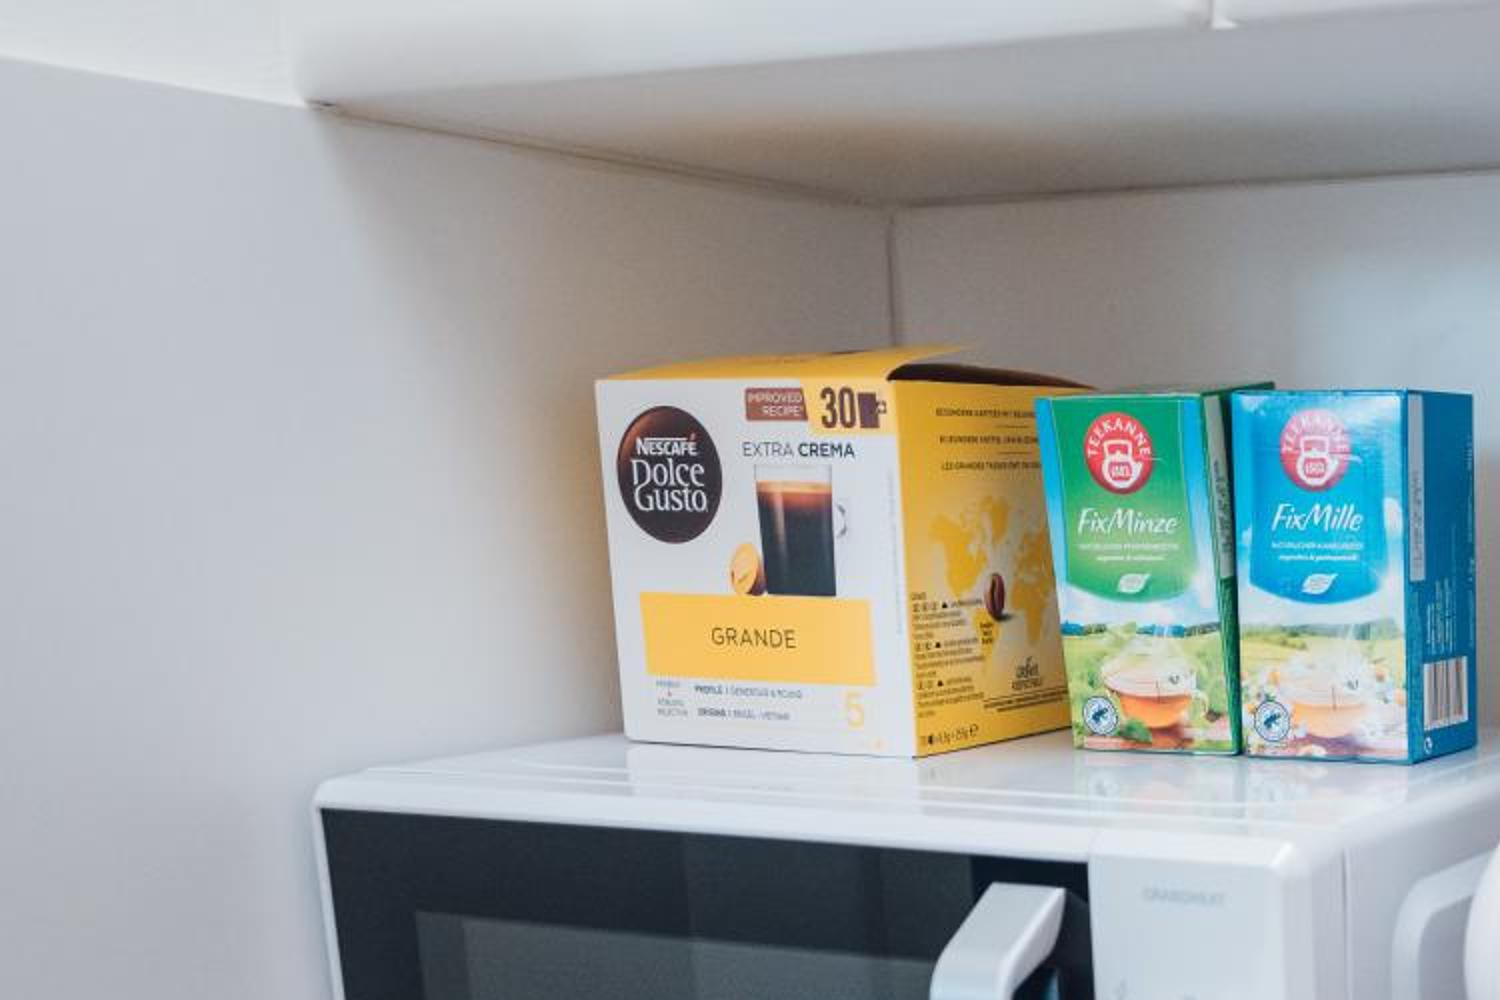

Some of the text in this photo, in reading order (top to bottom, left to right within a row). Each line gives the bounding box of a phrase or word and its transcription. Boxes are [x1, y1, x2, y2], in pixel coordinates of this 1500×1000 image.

[762, 404, 802, 417] RECIPE
[820, 387, 857, 428] 30
[742, 441, 856, 459] EXTRA CREMA
[1087, 417, 1152, 458] TEEKANNE
[632, 457, 705, 487] Dolce
[634, 484, 709, 512] Gusto
[711, 626, 797, 649] GRANDE
[845, 692, 865, 729] 5
